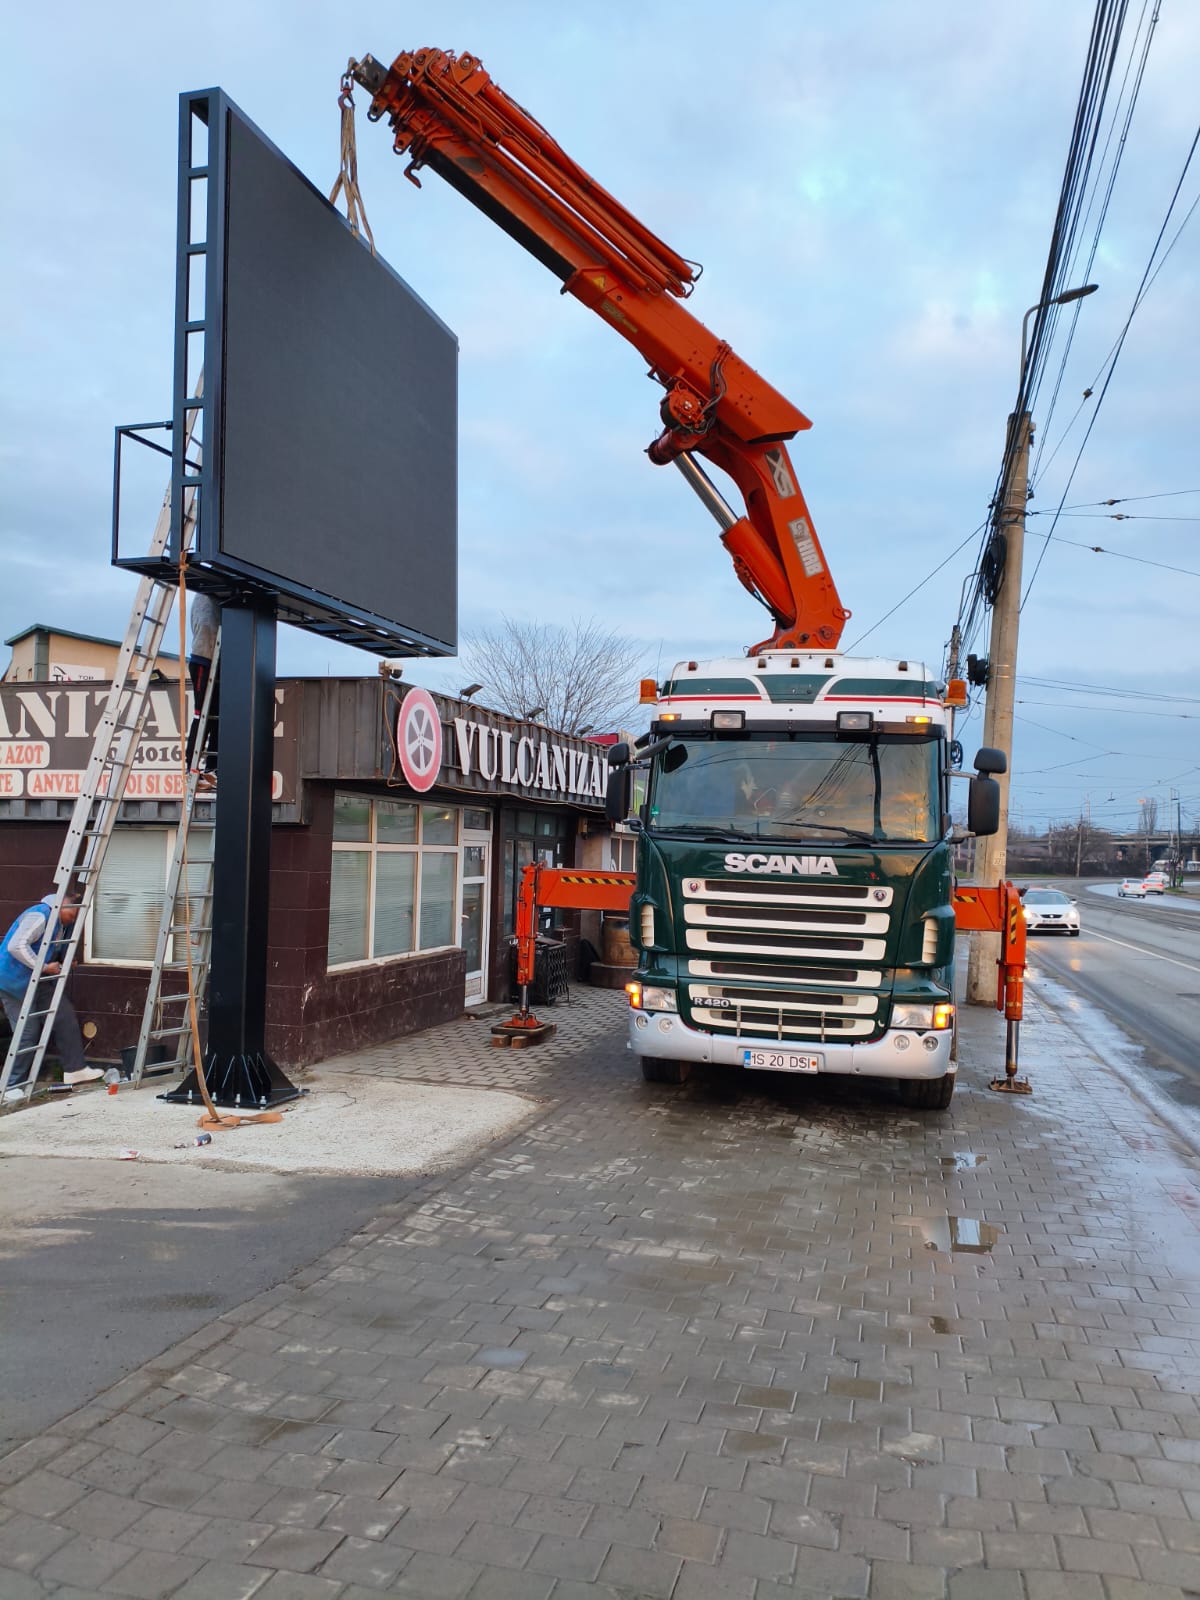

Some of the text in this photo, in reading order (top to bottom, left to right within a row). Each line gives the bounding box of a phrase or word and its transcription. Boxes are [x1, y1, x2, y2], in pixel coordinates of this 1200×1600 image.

[5, 745, 44, 764] AZOT
[454, 717, 619, 798] VULCANIZA
[146, 774, 160, 794] SI
[724, 853, 839, 876] SCANIA
[769, 1054, 784, 1067] 20
